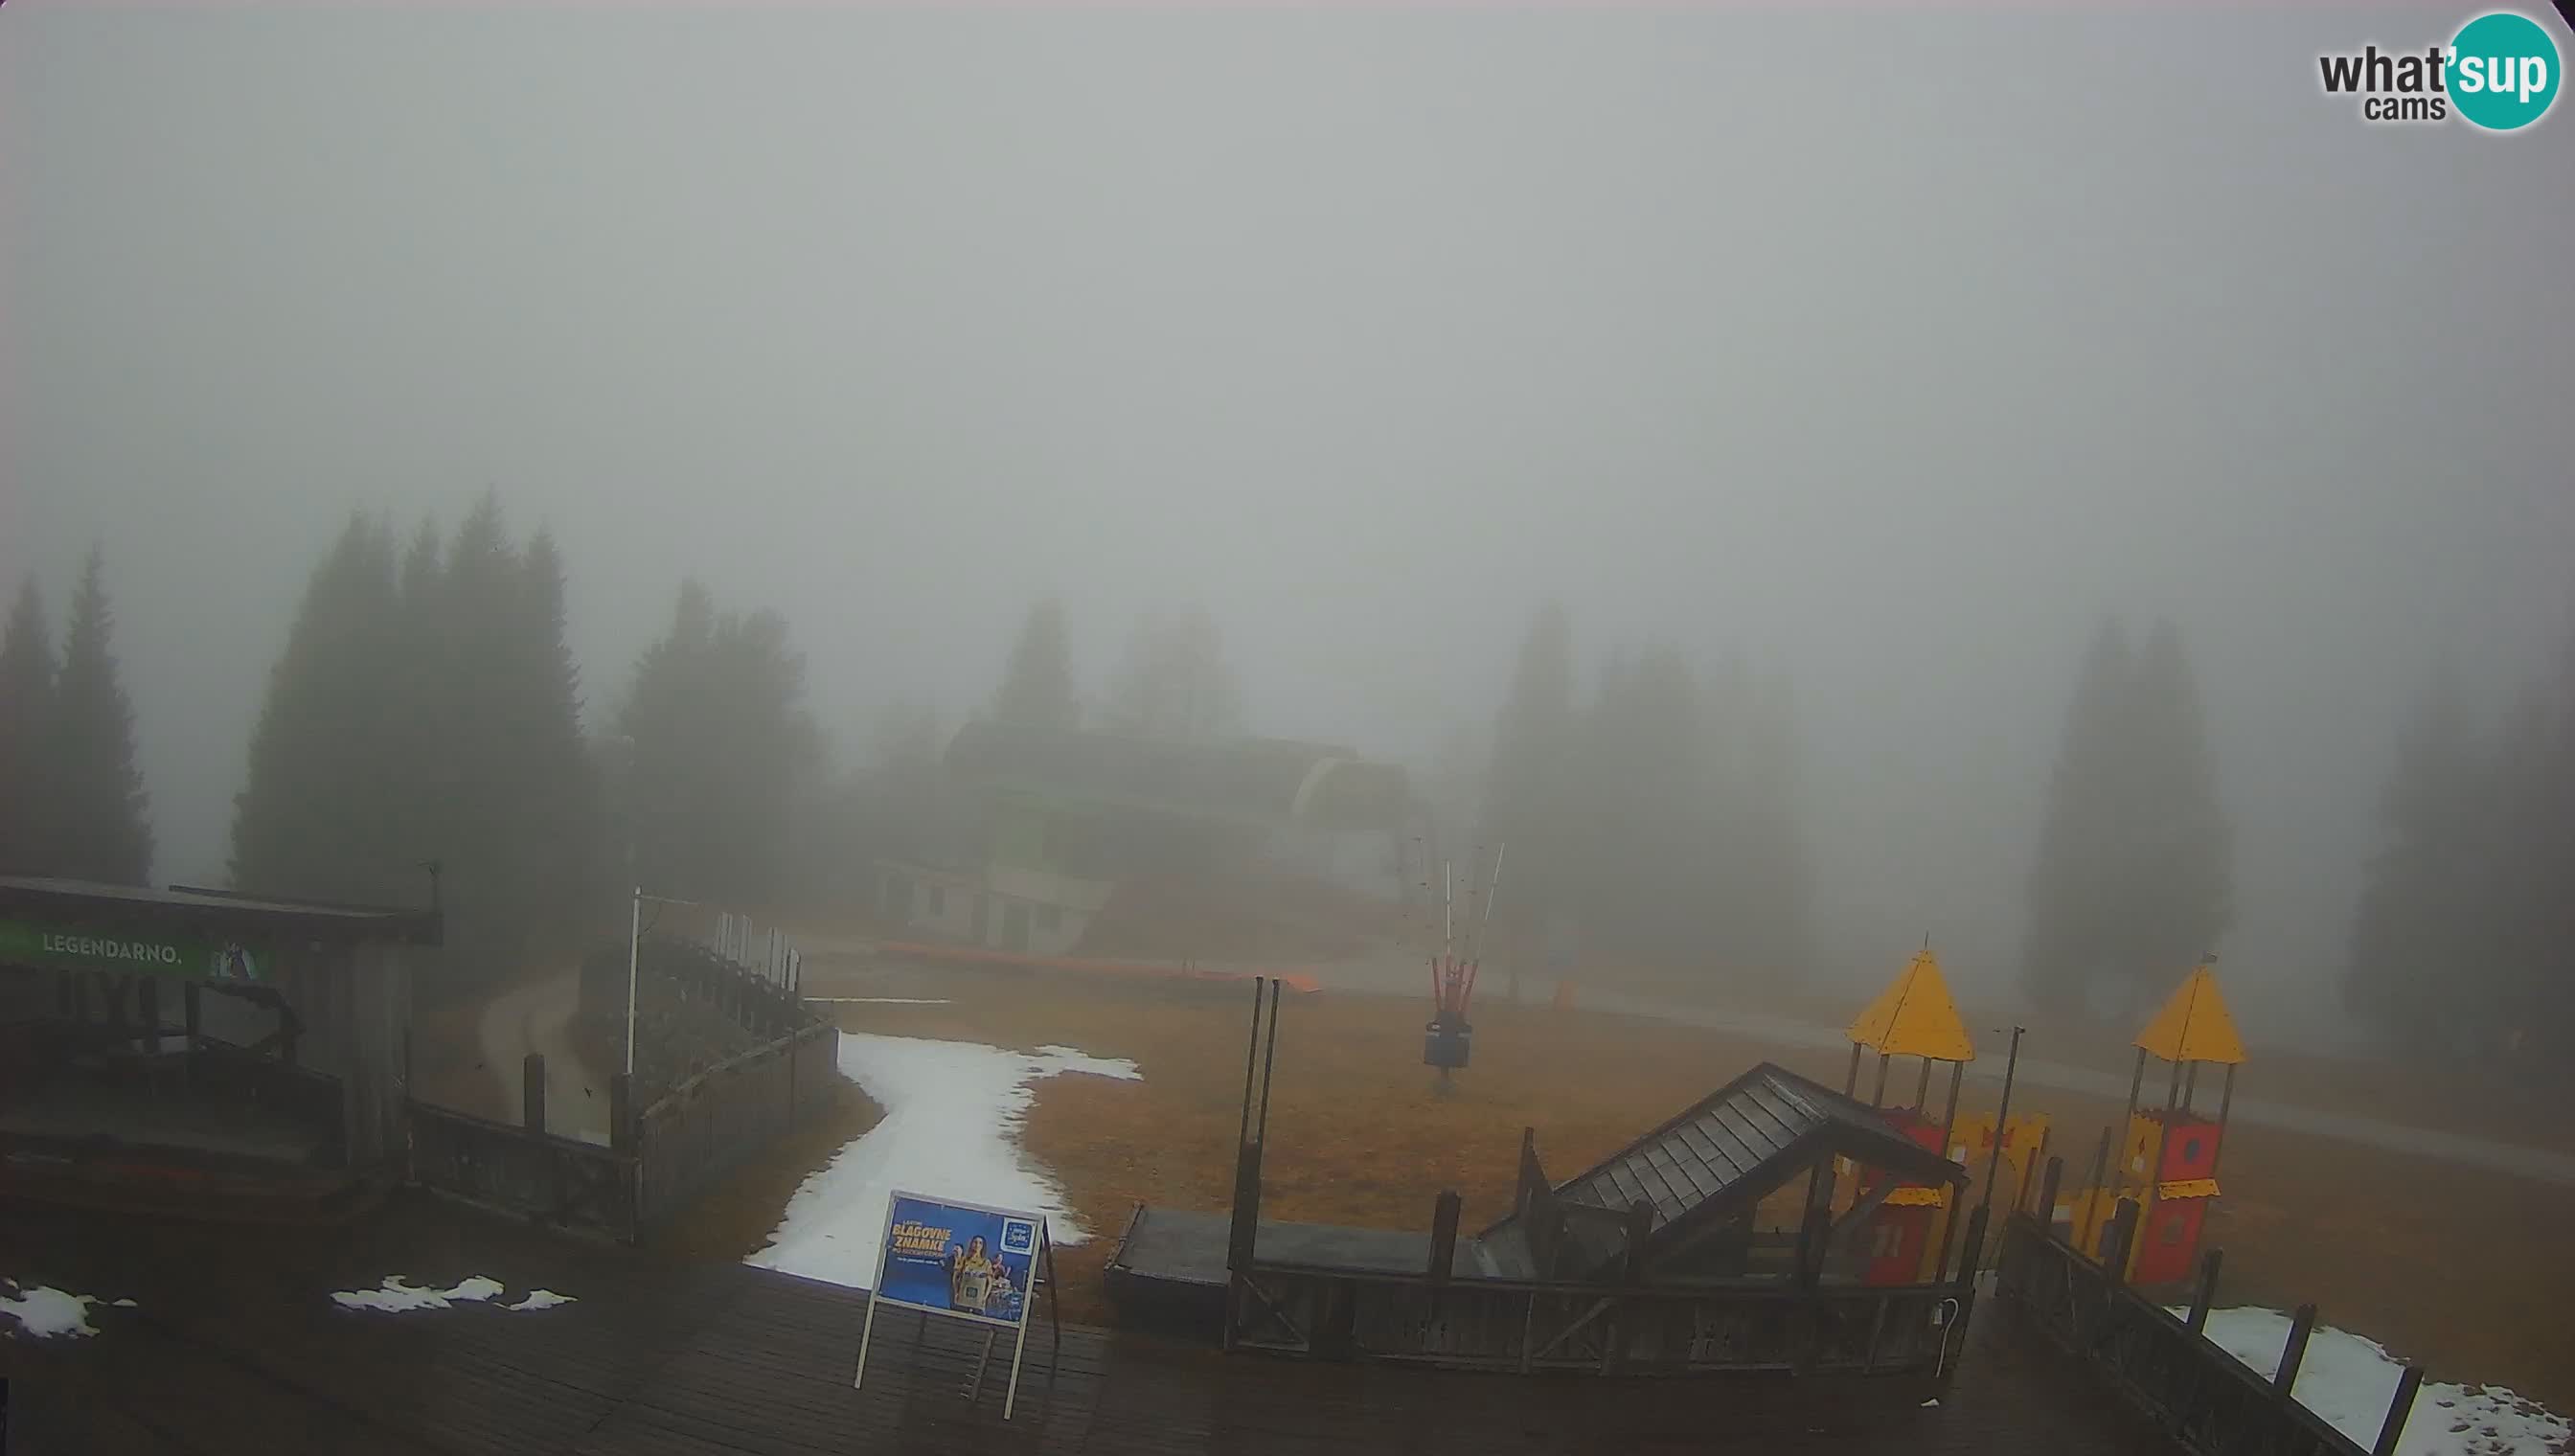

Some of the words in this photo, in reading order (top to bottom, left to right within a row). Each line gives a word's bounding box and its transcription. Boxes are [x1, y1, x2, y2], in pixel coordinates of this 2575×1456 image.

[42, 933, 183, 966] LEGENDARNO.
[892, 1224, 952, 1241] BLAGOVNE
[895, 1236, 946, 1252] ZNAMKE
